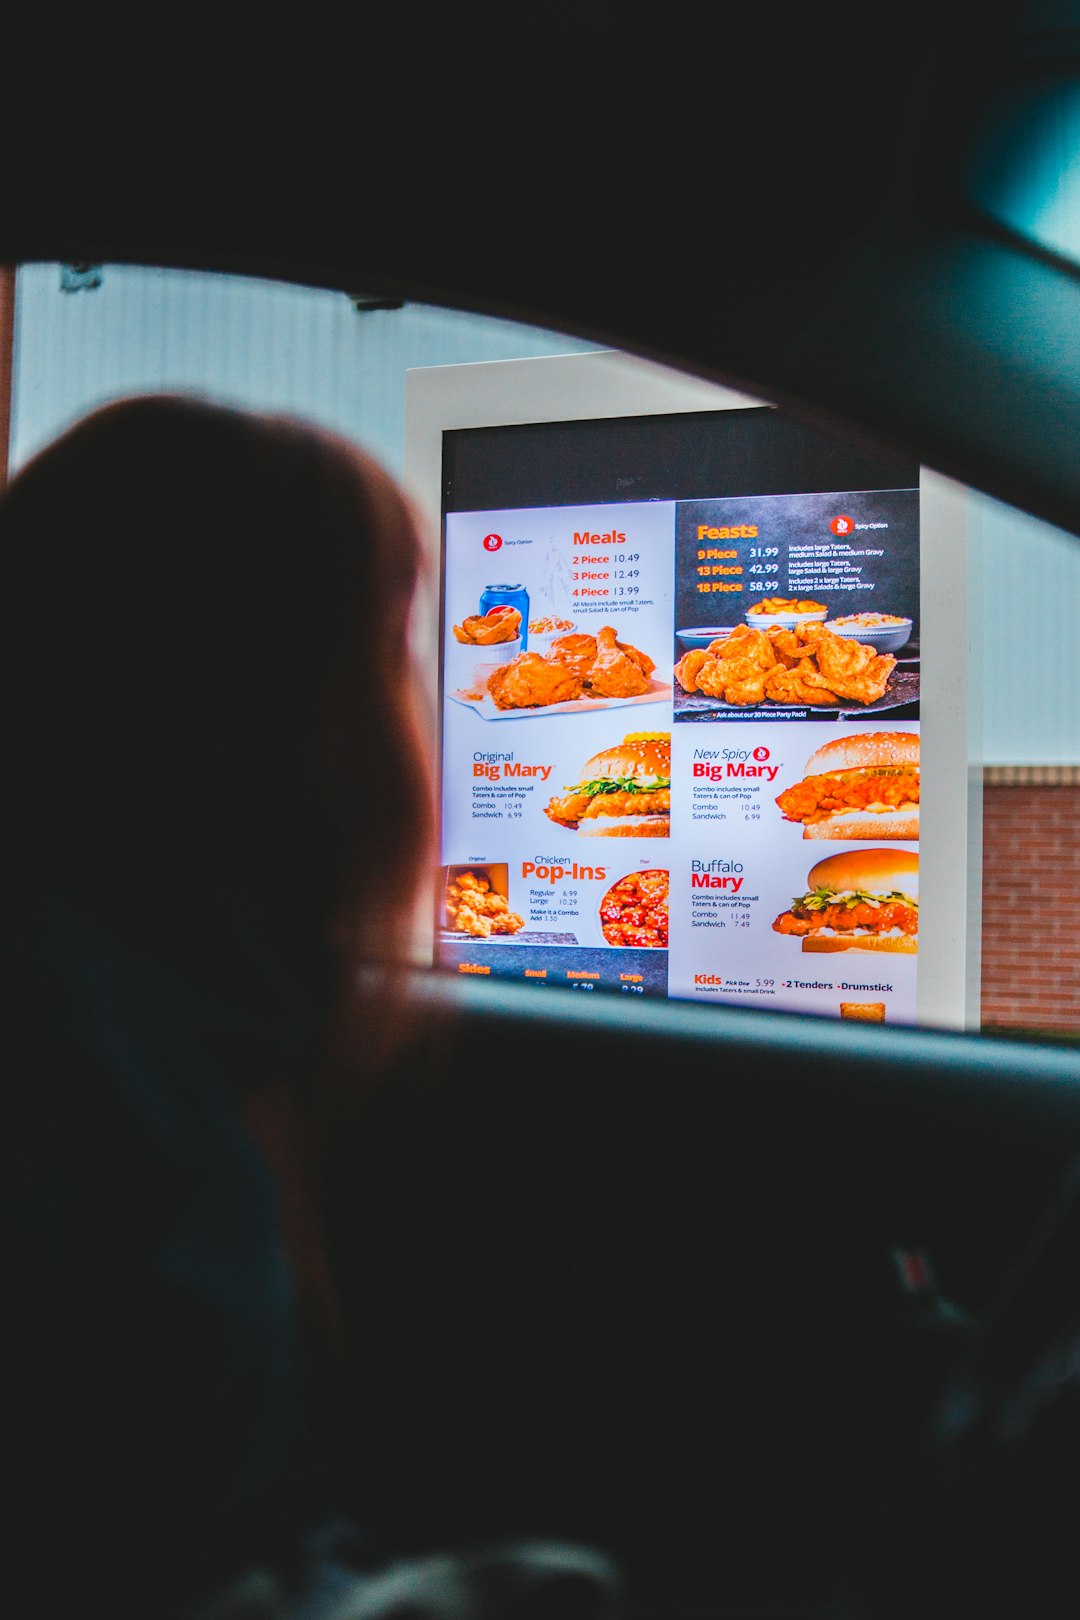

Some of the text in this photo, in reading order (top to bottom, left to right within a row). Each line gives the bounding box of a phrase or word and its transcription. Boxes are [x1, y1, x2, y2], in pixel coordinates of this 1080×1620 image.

[573, 530, 626, 545] Meals
[698, 524, 758, 540] Feasts
[582, 556, 609, 564] Piece
[614, 554, 640, 562] 10.49
[698, 547, 778, 560] 9 Piece 31.99
[582, 572, 609, 580] Piece
[614, 570, 640, 579] 12.49
[697, 564, 778, 576] 13 Piece 42.99
[582, 588, 609, 596] Piece
[614, 587, 639, 595] 13.99
[697, 581, 778, 592] 18 Piece 58.99
[474, 752, 514, 764] Original
[694, 748, 751, 762] New Spicy
[473, 763, 552, 781] Big Mary
[693, 762, 779, 781] Big Mary
[535, 856, 570, 864] Chicken
[692, 860, 744, 873] Buffalo
[522, 862, 606, 884] Pop-Ins
[692, 874, 744, 893] Mary
[458, 963, 644, 983] Sides Small Medium Large
[694, 974, 722, 985] Kids
[756, 979, 774, 987] 5.99
[794, 981, 833, 989] Tenders
[841, 982, 893, 992] Drumstick
